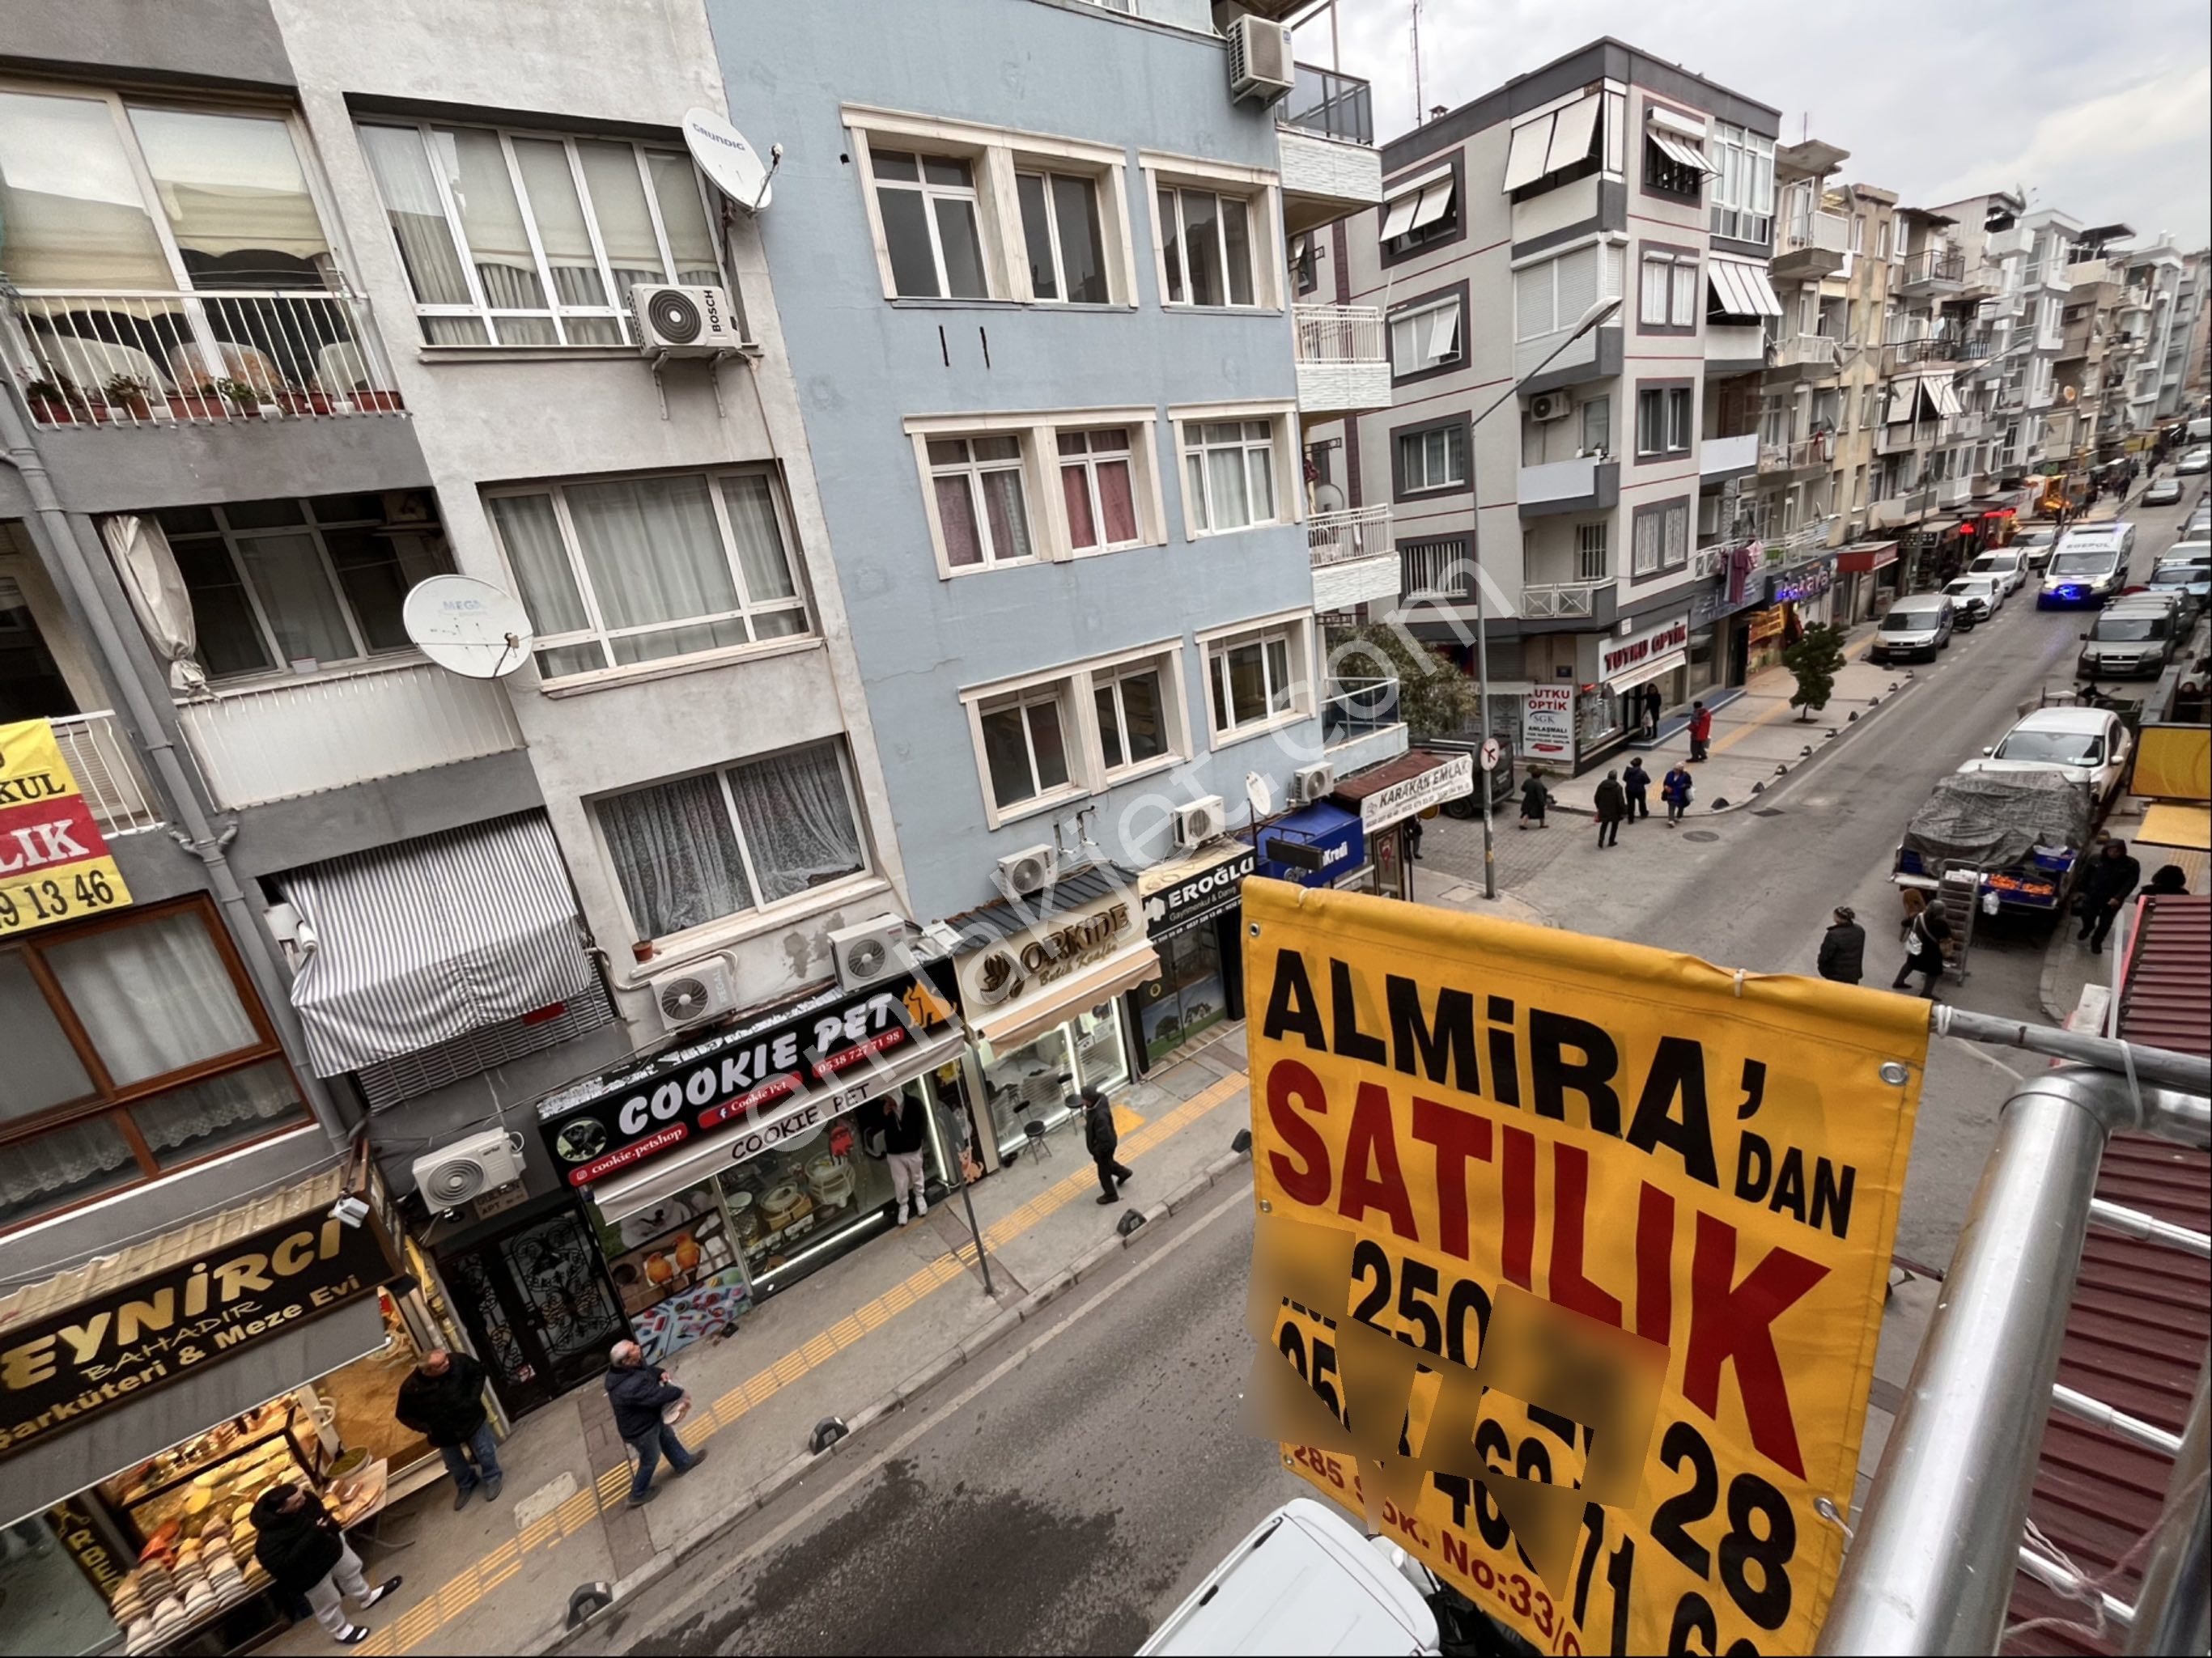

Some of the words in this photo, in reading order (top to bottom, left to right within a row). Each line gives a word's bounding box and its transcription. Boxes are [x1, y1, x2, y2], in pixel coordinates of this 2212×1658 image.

[692, 123, 745, 151] GRUNDIG
[703, 290, 721, 333] BOSCH
[1604, 639, 1649, 673] TUTKU
[1528, 698, 1568, 710] OPTİK
[1530, 689, 1570, 699] UTKU
[1534, 715, 1555, 724] SGK
[1379, 776, 1430, 808] KARAKAN
[24, 879, 68, 920] 13
[74, 869, 114, 908] 46
[1168, 856, 1255, 909] EROĞLU
[618, 1032, 797, 1135] COOKIE
[813, 992, 894, 1053] PET
[817, 1054, 847, 1074] 0538
[885, 1032, 900, 1043] 98
[730, 1091, 767, 1112] Cookie
[768, 1081, 788, 1096] Pet
[732, 1105, 819, 1159] COOKIE
[832, 1083, 870, 1113] PET
[592, 1129, 682, 1174] cookie.petshop
[1267, 1058, 1832, 1482] SATILIK
[80, 1300, 263, 1383] BAHADIR
[177, 1343, 206, 1366] &
[214, 1302, 303, 1348] Meze
[311, 1274, 360, 1308] Evi
